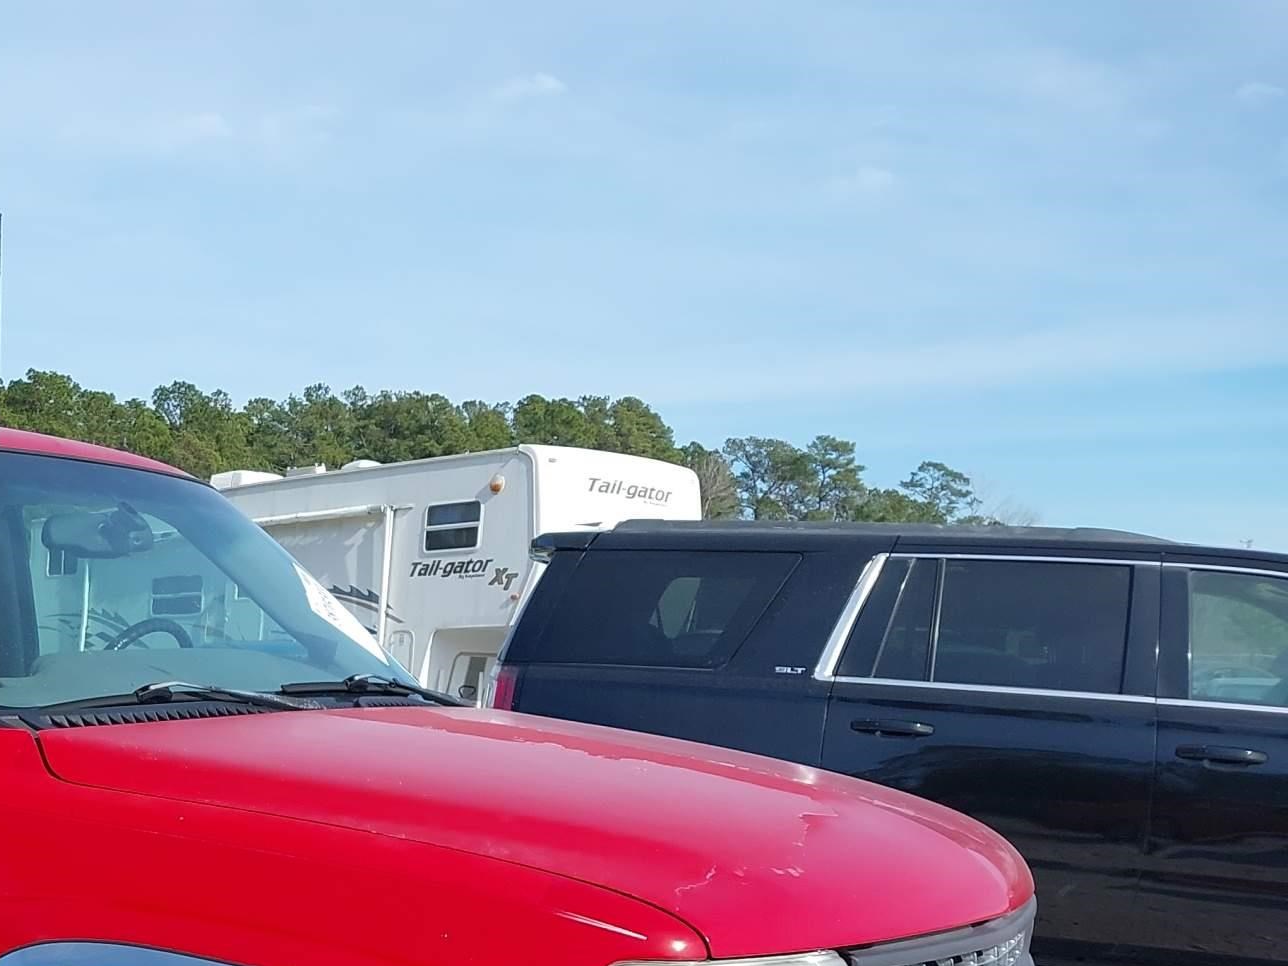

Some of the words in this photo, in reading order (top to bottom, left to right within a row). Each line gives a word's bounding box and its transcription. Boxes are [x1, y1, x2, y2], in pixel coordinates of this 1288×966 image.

[588, 477, 672, 499] Tail-gator
[409, 558, 495, 578] Tail-gator
[488, 567, 520, 591] XT
